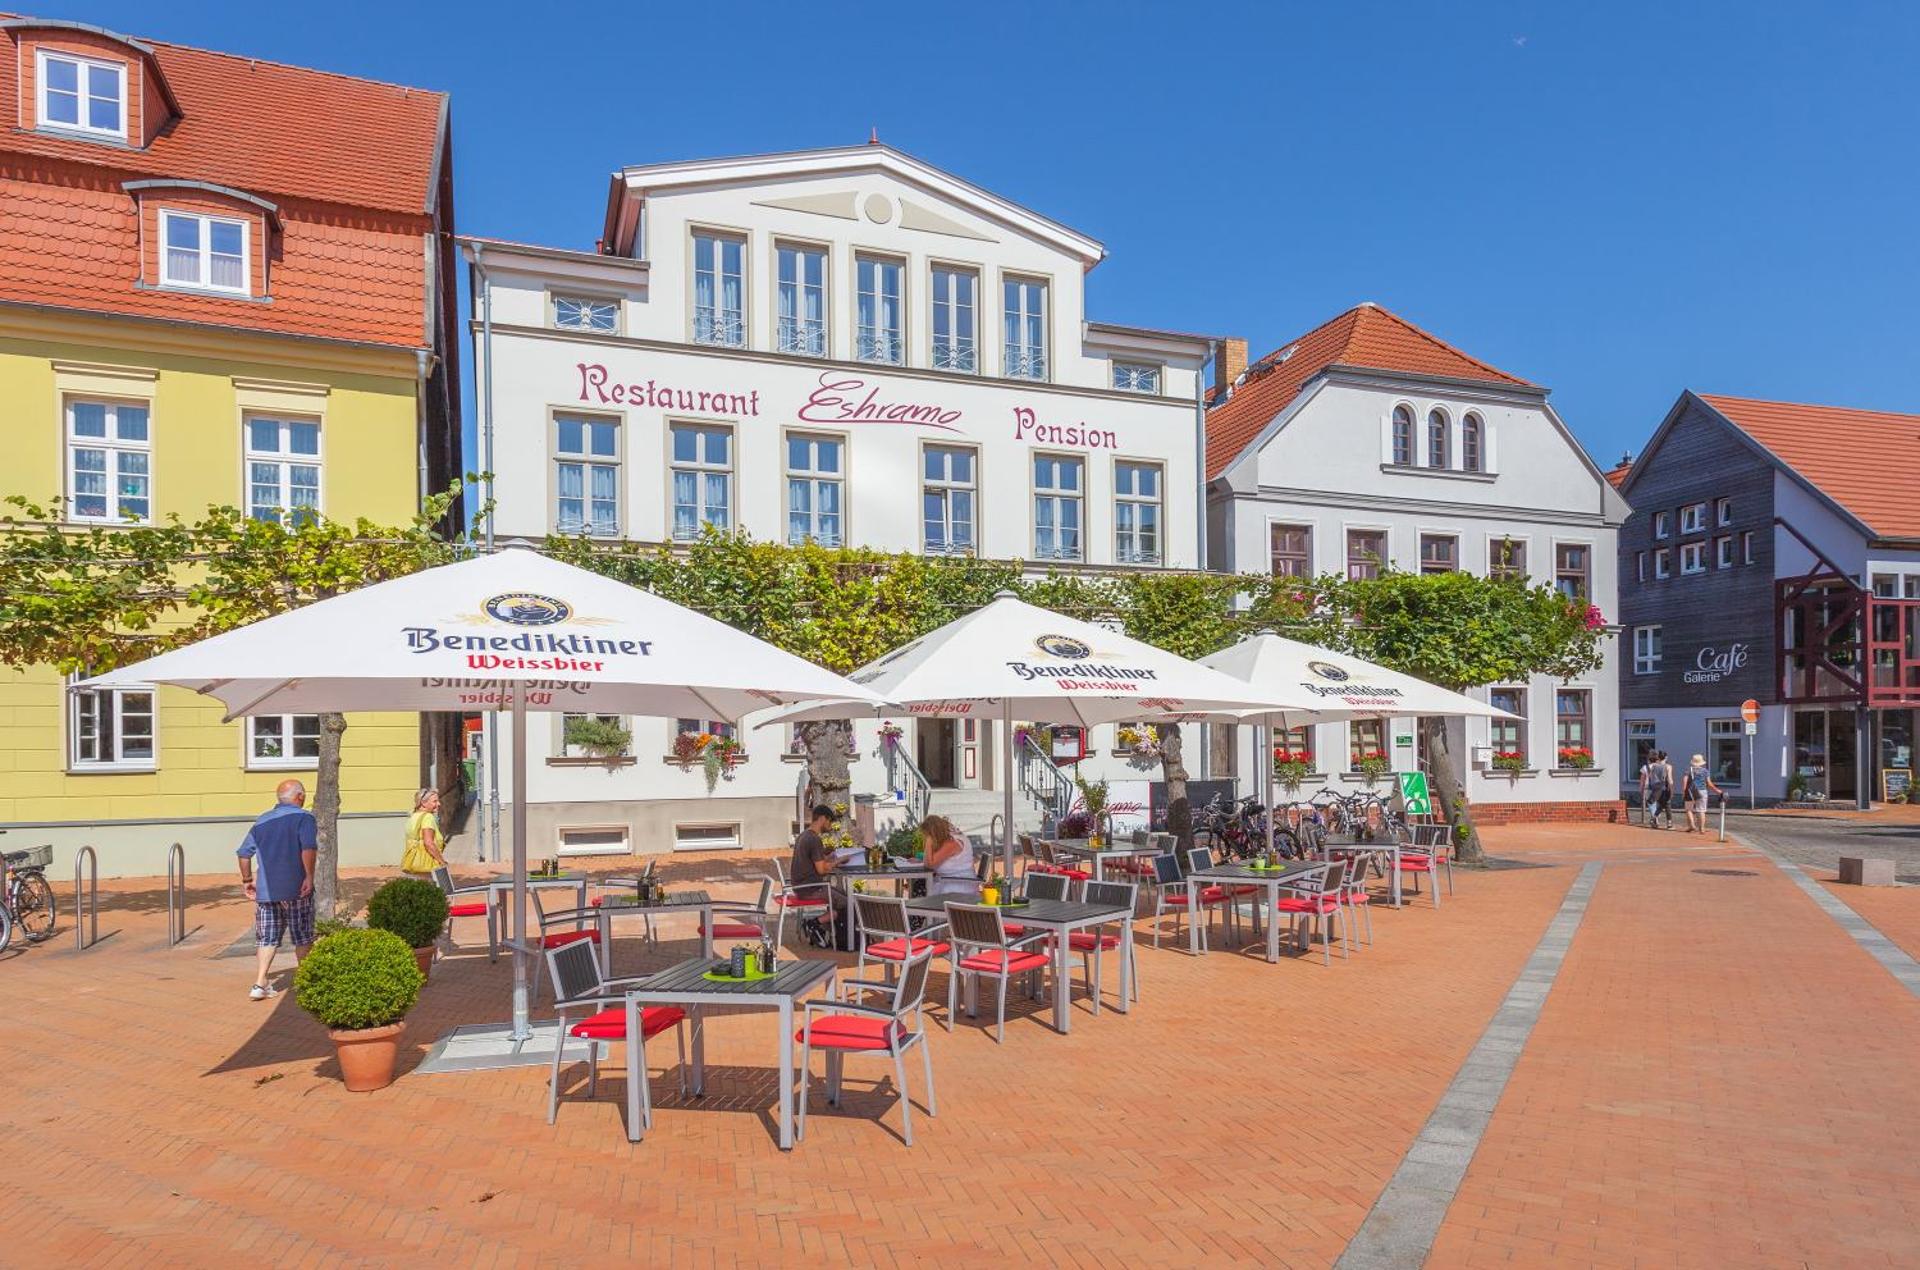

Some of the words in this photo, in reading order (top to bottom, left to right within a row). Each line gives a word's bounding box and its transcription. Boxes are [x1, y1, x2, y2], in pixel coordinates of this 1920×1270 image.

[576, 363, 760, 417] Restaurant
[798, 370, 967, 434] Eshramo
[1013, 406, 1118, 450] Pension
[401, 627, 653, 656] Benediktiner
[467, 655, 604, 672] Weissbier
[1006, 662, 1158, 681] Benediktiner
[1697, 643, 1749, 675] Café
[1056, 679, 1138, 691] Weissbier
[1684, 672, 1721, 683] Galerie
